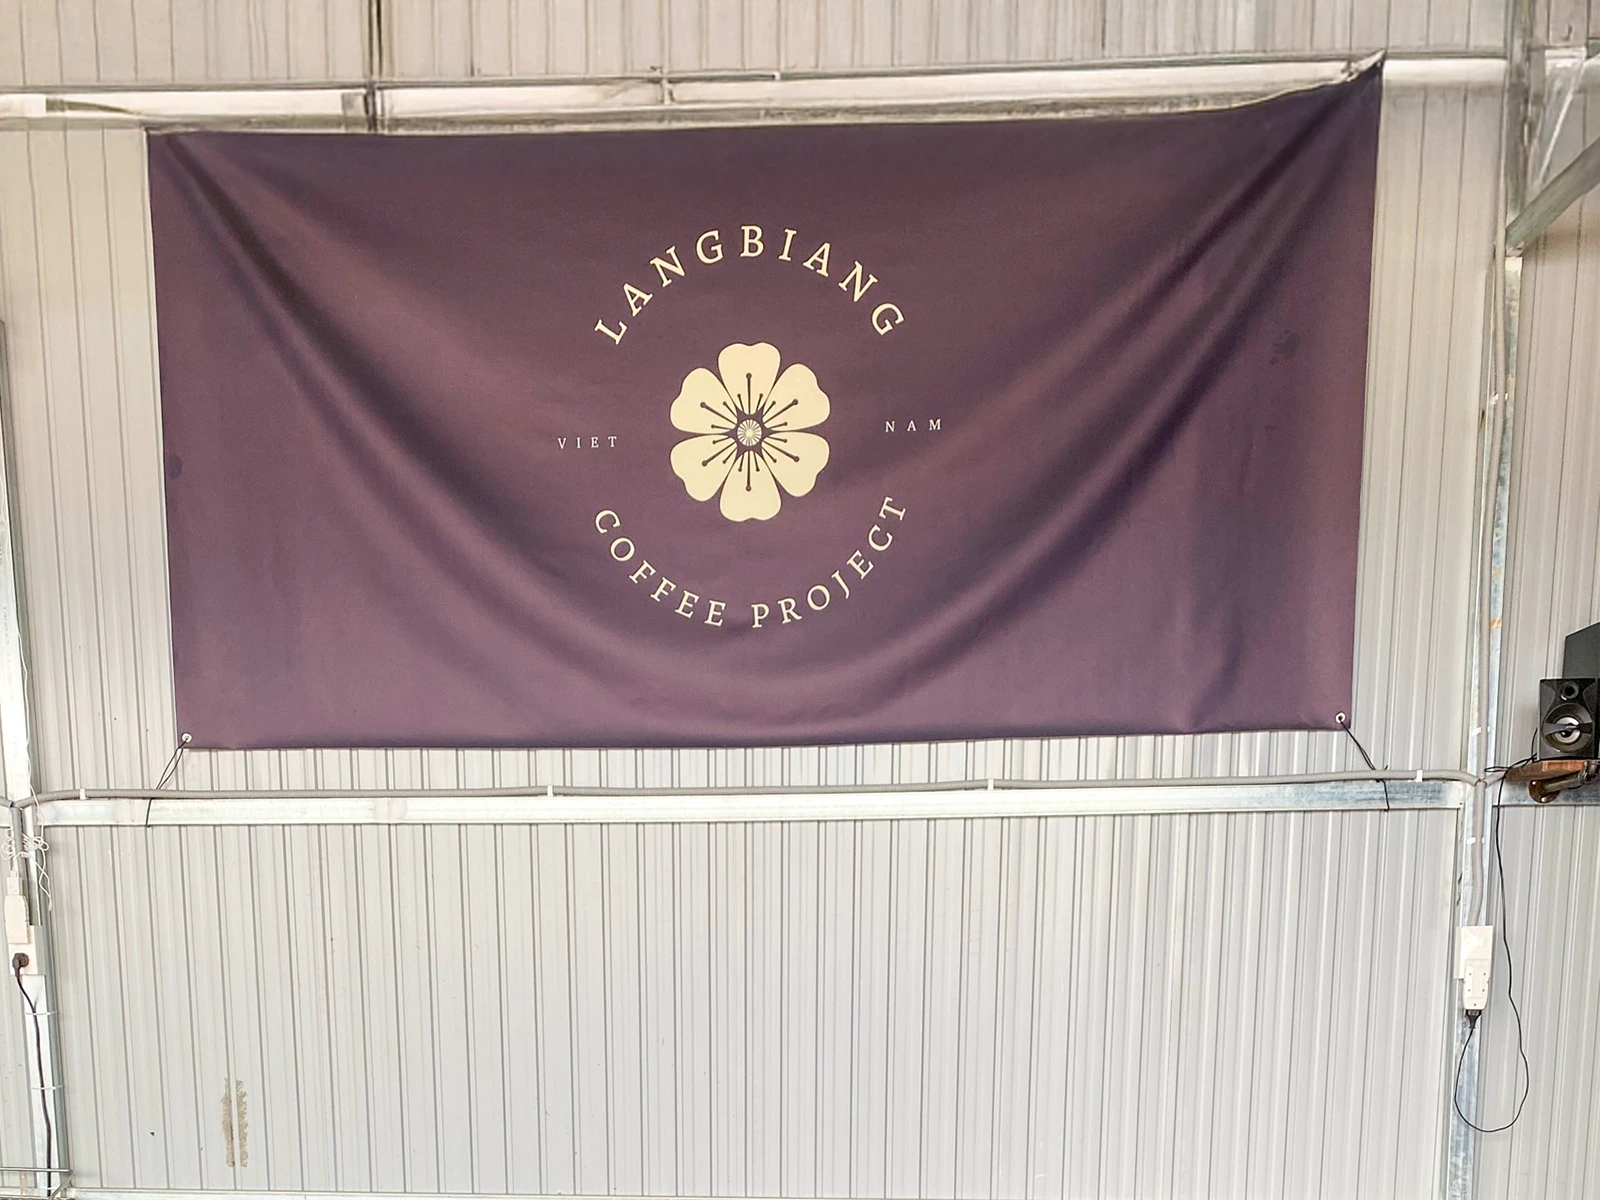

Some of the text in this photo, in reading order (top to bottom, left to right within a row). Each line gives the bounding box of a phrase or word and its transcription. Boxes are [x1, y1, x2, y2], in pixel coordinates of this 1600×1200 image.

[594, 225, 905, 346] LANGBIANG
[557, 418, 941, 449] VIET NAM
[595, 496, 906, 629] COFFEE PROJECT
